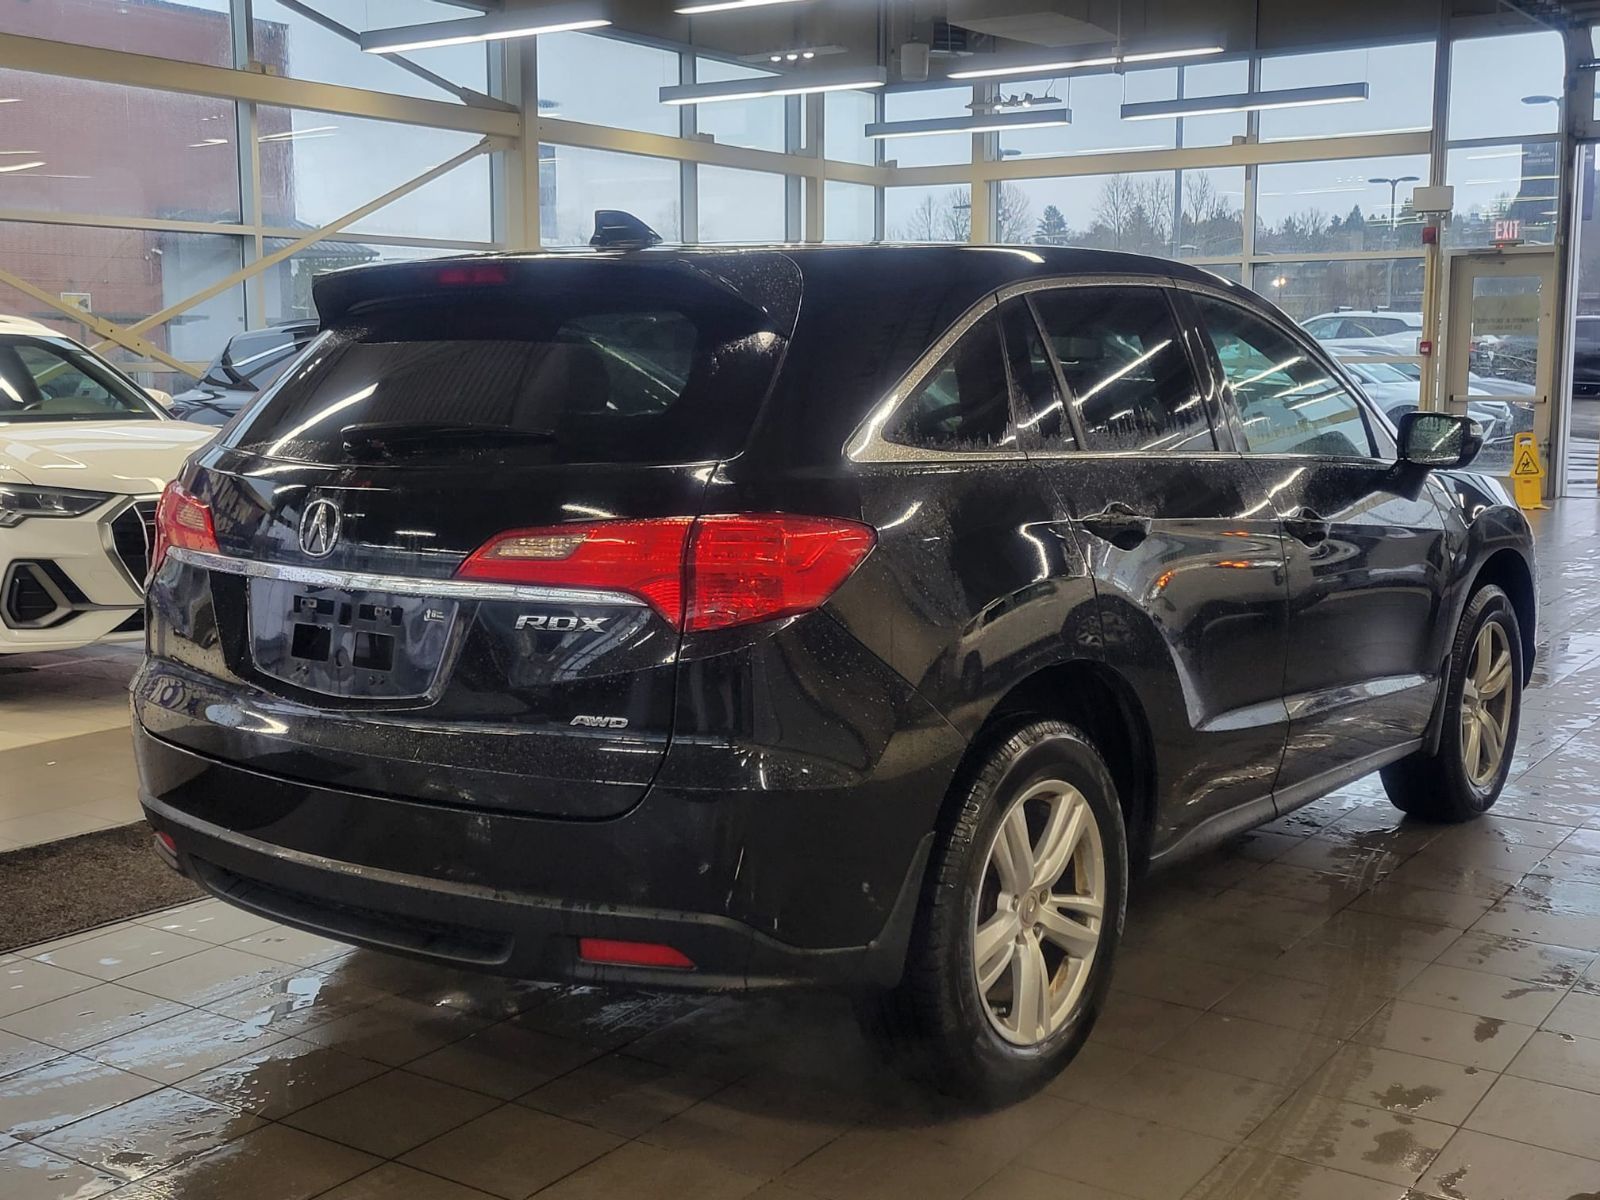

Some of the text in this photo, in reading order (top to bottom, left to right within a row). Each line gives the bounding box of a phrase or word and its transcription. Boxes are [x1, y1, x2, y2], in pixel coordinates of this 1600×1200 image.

[1495, 220, 1520, 239] EXIT
[515, 614, 610, 633] RDX
[569, 715, 629, 729] AWD
